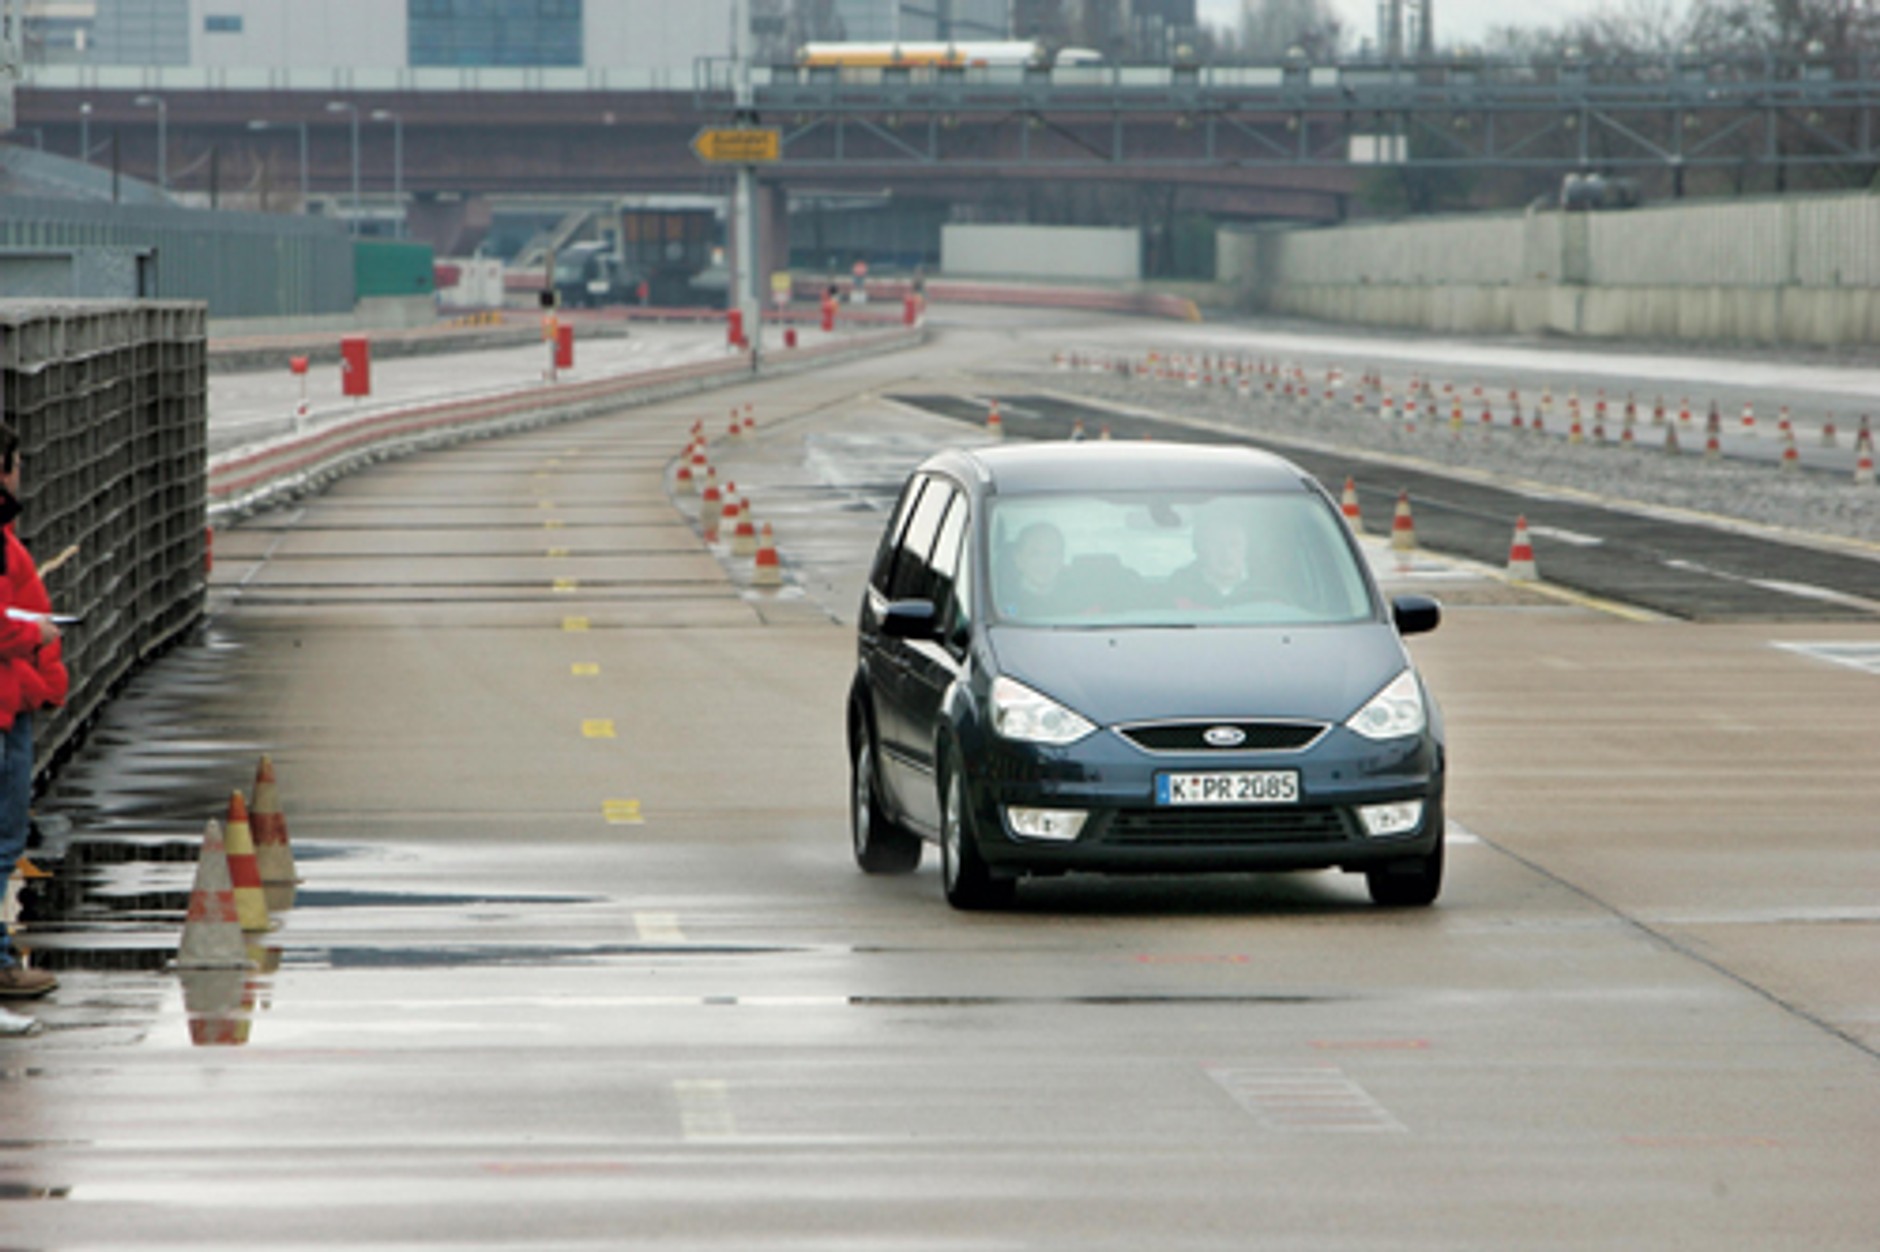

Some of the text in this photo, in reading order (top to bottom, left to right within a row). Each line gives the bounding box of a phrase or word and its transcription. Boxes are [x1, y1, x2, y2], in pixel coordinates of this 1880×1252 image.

[1173, 775, 1295, 798] K PR 2085
